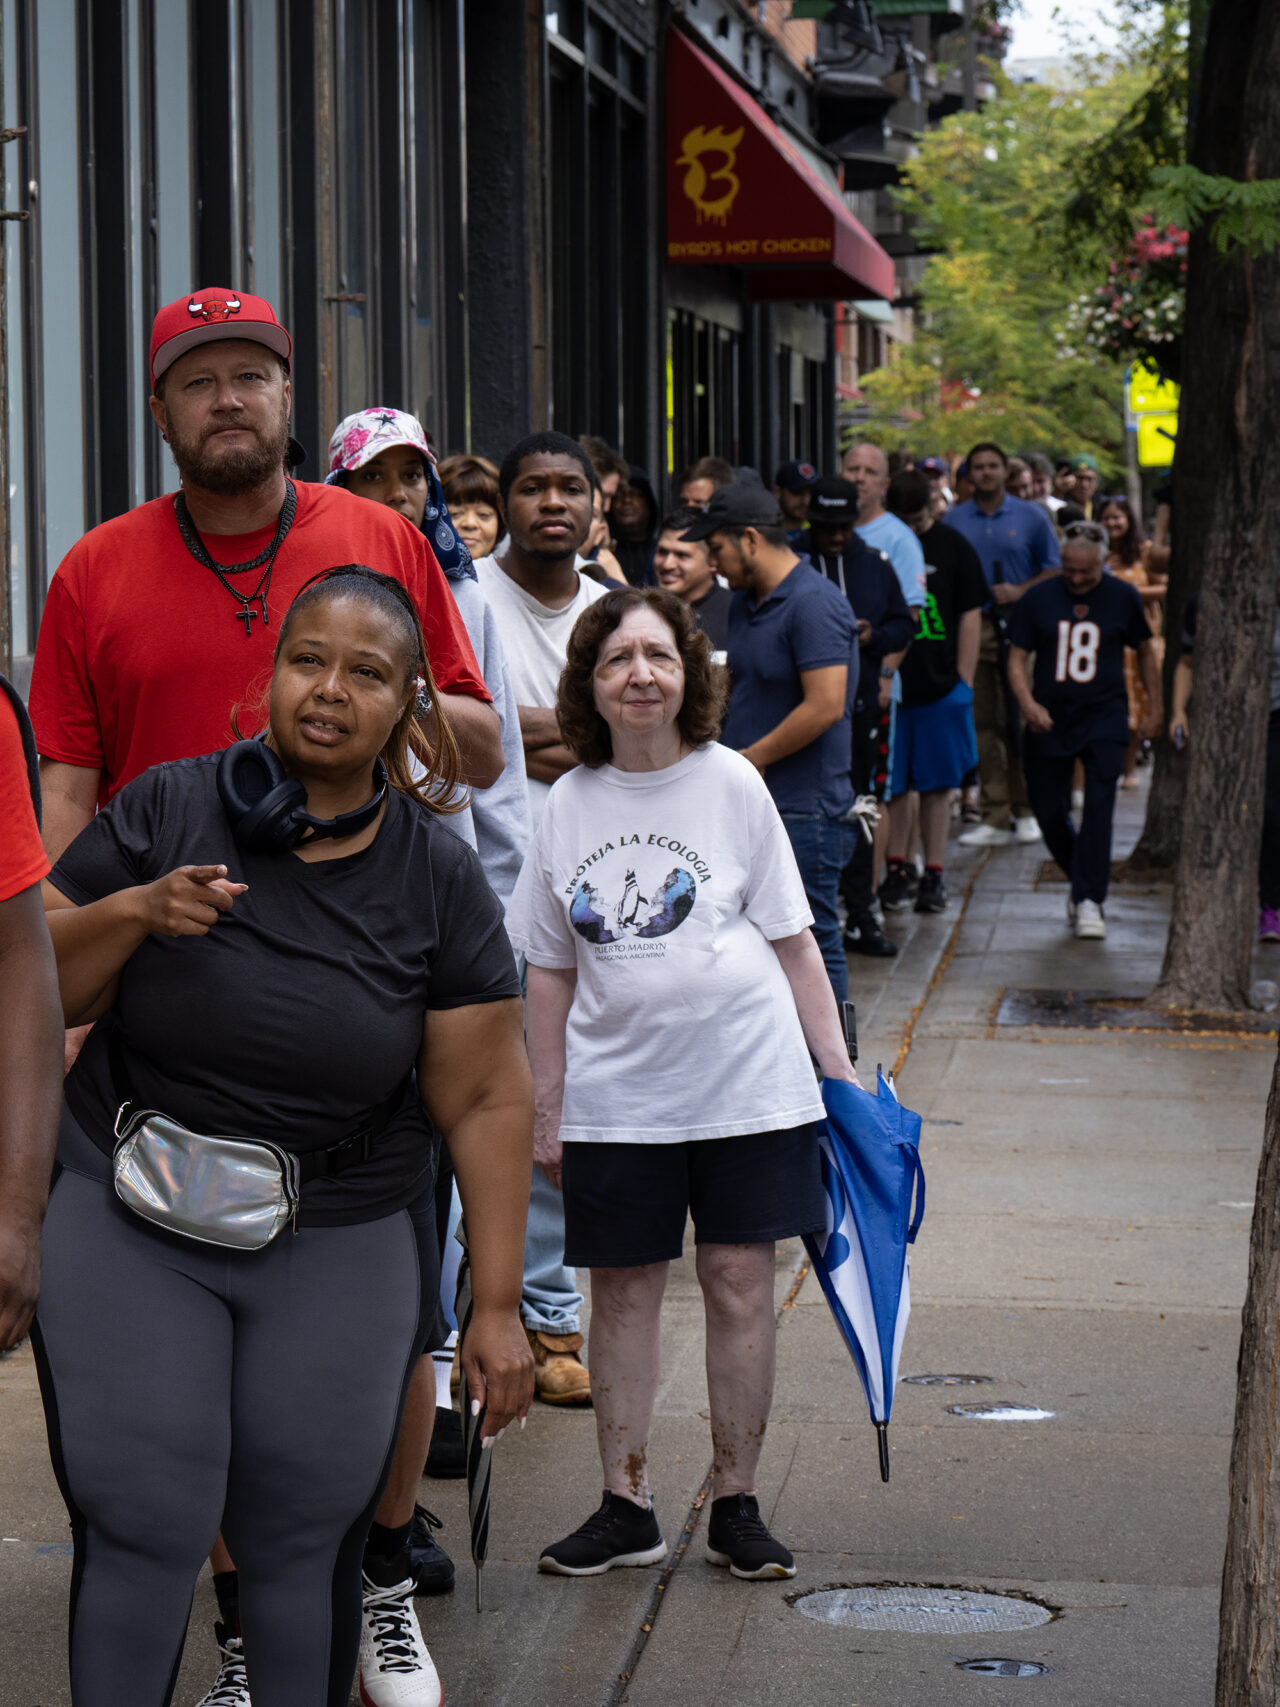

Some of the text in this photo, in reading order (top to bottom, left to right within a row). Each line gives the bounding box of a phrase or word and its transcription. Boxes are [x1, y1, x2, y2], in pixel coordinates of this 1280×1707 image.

[668, 237, 832, 258] BYRD'S HOT CHICKEN
[1055, 619, 1101, 683] 18
[565, 834, 712, 895] PROTEJA LA ECOLOGIA
[594, 942, 667, 954] PUERTO MADRYN
[629, 952, 666, 960] ARGENTINA
